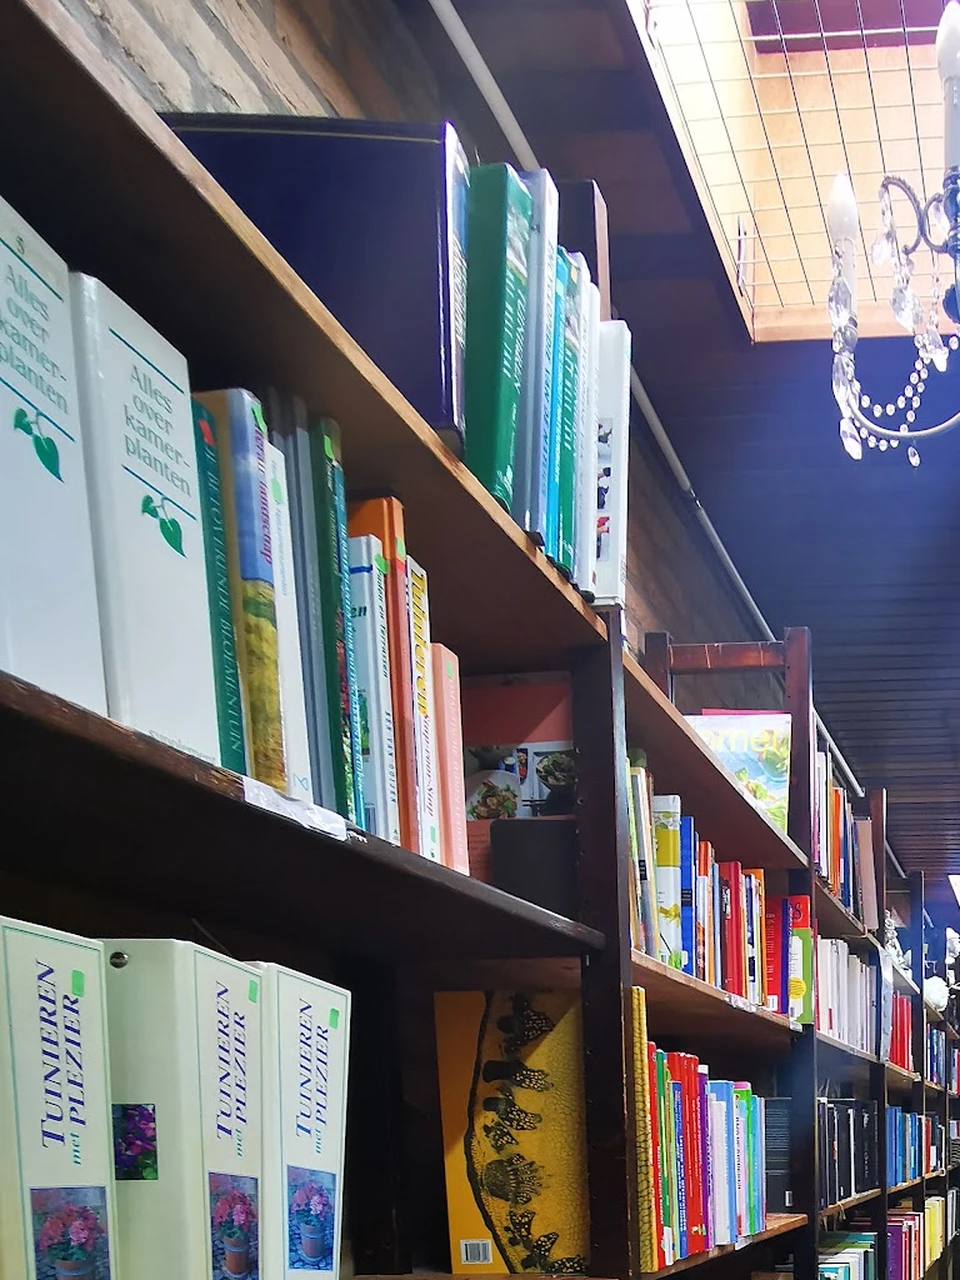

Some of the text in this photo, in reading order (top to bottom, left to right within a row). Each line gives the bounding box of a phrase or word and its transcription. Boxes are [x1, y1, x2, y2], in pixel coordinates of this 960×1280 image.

[6, 264, 50, 322] Alles
[7, 296, 50, 344] over
[0, 340, 69, 415] planten
[131, 364, 173, 414] Alles
[132, 391, 173, 435] over
[123, 404, 191, 468] kamer-
[124, 433, 192, 498] planten
[258, 480, 274, 565] landschap
[378, 604, 385, 620] en
[219, 619, 242, 754] BLOEMENTUIN
[379, 622, 390, 681] Terrassen
[409, 568, 434, 817] Tuinieren Stap-voor-Stap
[386, 736, 394, 758] VAN
[38, 958, 66, 1150] TUINIEREN
[63, 992, 87, 1166] met PLEZIER
[215, 979, 236, 1141] TUINIEREN
[232, 1010, 248, 1158] met PLEZIER
[295, 997, 315, 1138] TUINIEREN
[312, 1023, 330, 1156] met PLEZIER
